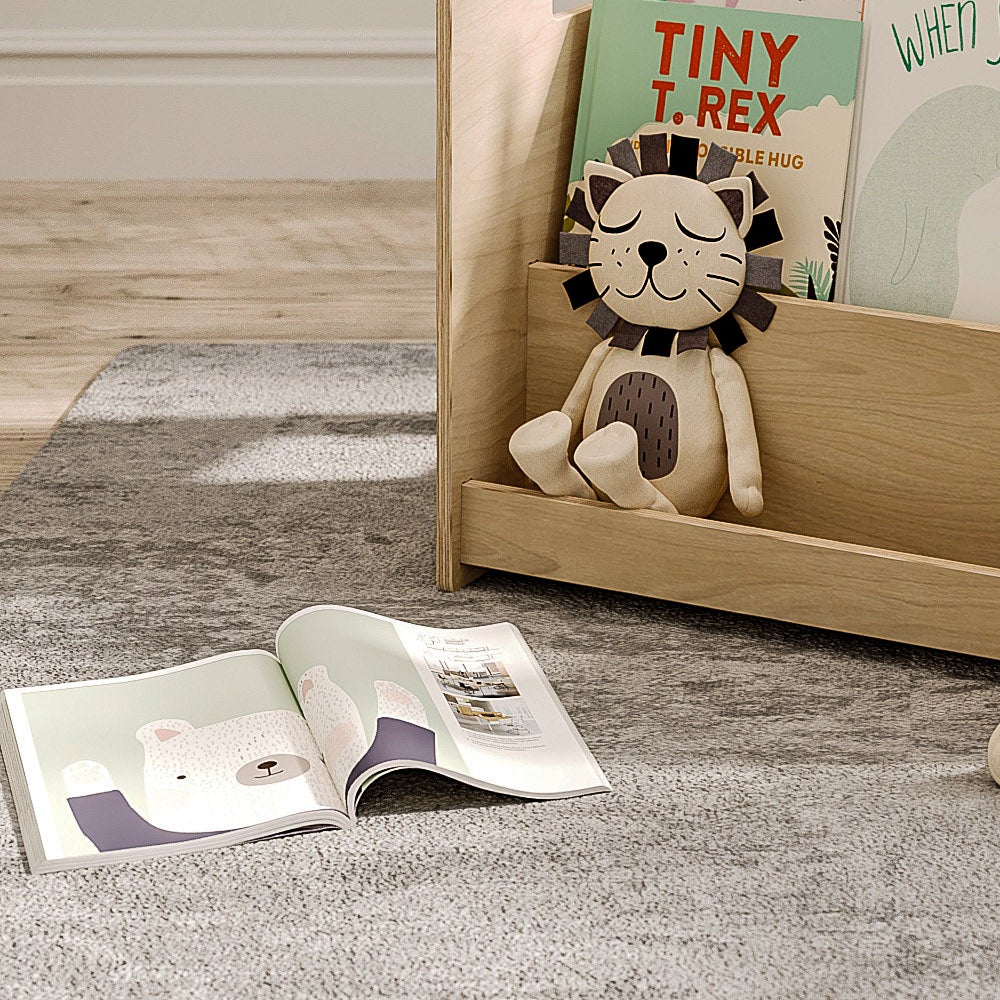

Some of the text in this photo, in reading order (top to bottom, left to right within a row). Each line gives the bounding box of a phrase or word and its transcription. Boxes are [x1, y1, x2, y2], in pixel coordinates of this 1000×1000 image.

[654, 20, 799, 88] TINY
[652, 80, 786, 137] T. REX
[768, 151, 804, 170] HUG
